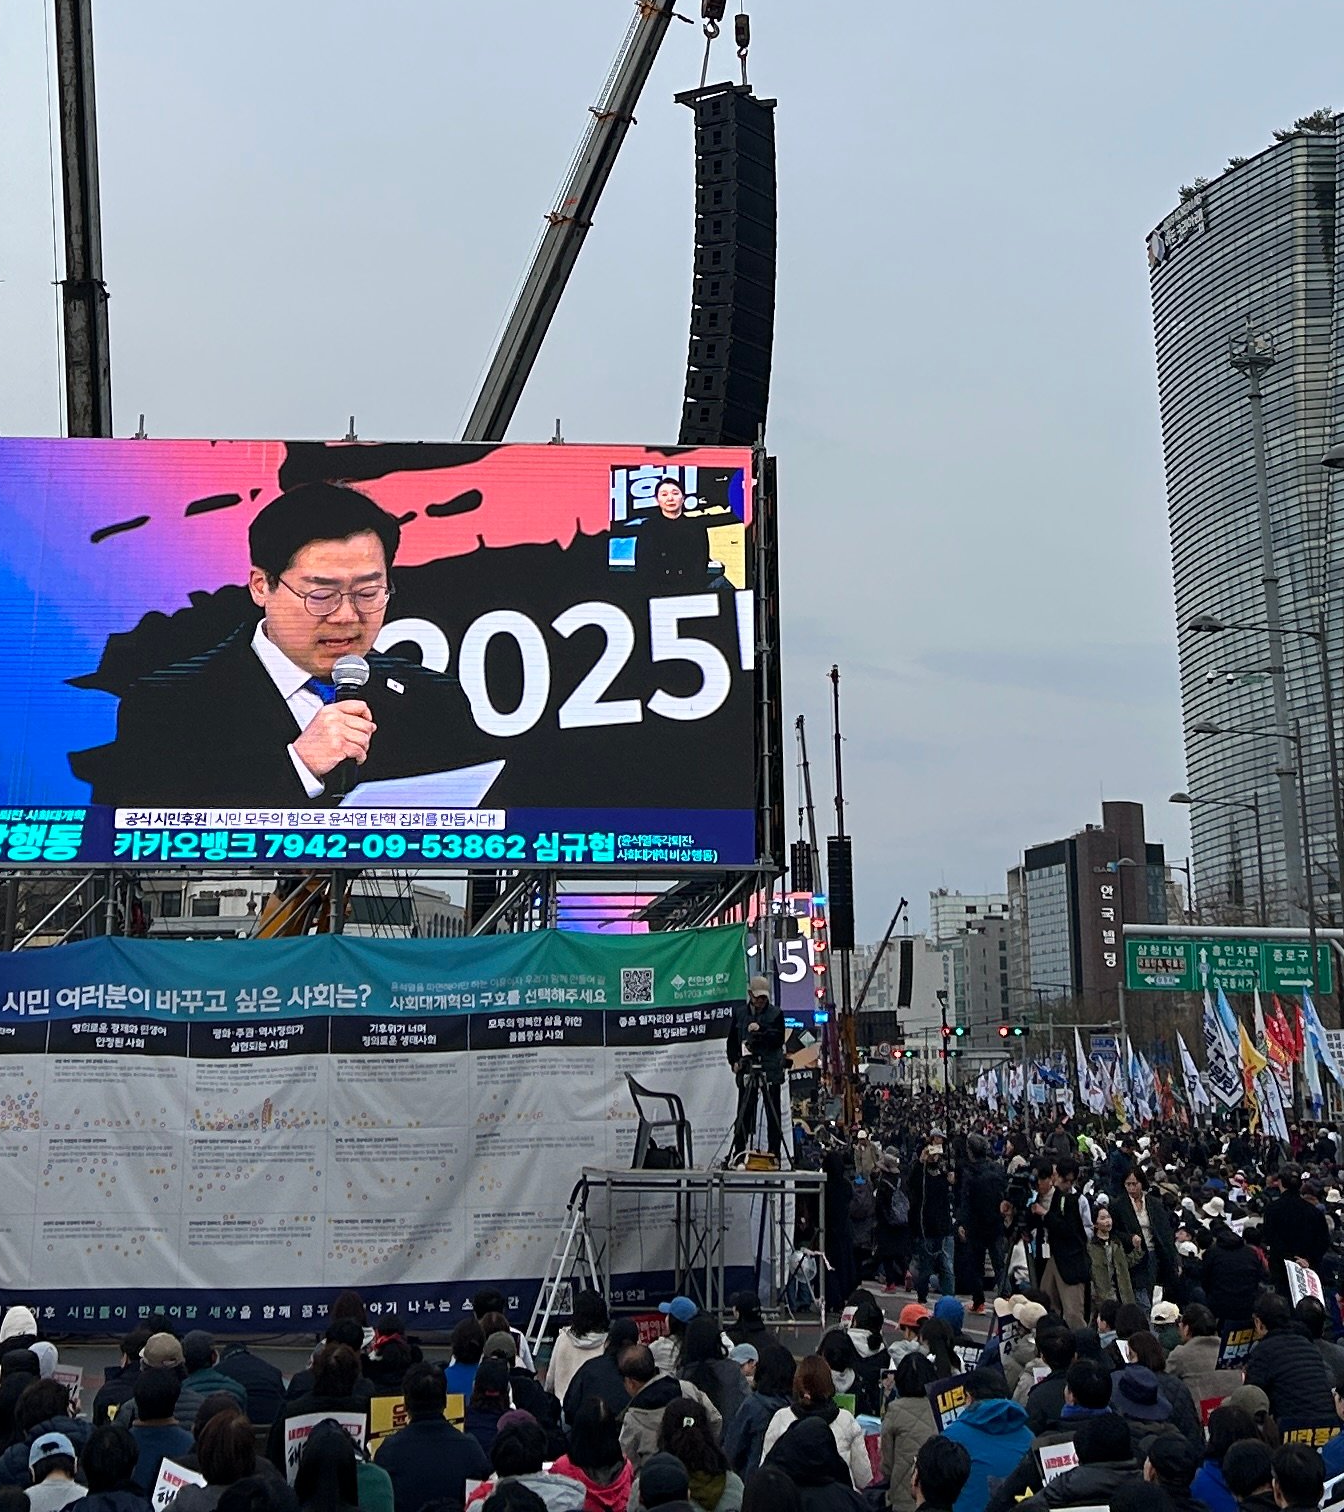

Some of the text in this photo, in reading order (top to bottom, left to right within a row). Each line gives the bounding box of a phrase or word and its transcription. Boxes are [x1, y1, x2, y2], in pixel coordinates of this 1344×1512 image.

[125, 812, 152, 826] 공식
[154, 812, 207, 826] 시민후원
[217, 812, 241, 826] 시민
[244, 812, 283, 827] 모두의
[287, 812, 325, 827] 힘으로
[329, 812, 367, 826] 윤석열
[371, 813, 396, 826] 탄핵
[399, 812, 438, 827] 집회를
[114, 831, 614, 862] 카카오뱅크 7942-09-53862 심규협
[1100, 884, 1117, 968] 안국빌딩
[1212, 945, 1259, 957] 흥인지문
[2, 983, 372, 1015] 시민 여러분이 바꾸고 싶은 사회는?
[389, 987, 606, 1011] 사회대개혁의 구호를 선택해주세요
[488, 1018, 515, 1029] 모두의
[545, 1029, 564, 1040] 사회
[125, 1037, 145, 1049] 사회
[269, 1039, 289, 1050] 사회
[30, 1305, 55, 1319] 이후
[67, 1305, 127, 1319] 시민들이
[208, 1305, 252, 1320] 세상을
[263, 1304, 291, 1319] 함께
[363, 1301, 398, 1315] 야기
[408, 1298, 452, 1313] 나누는
